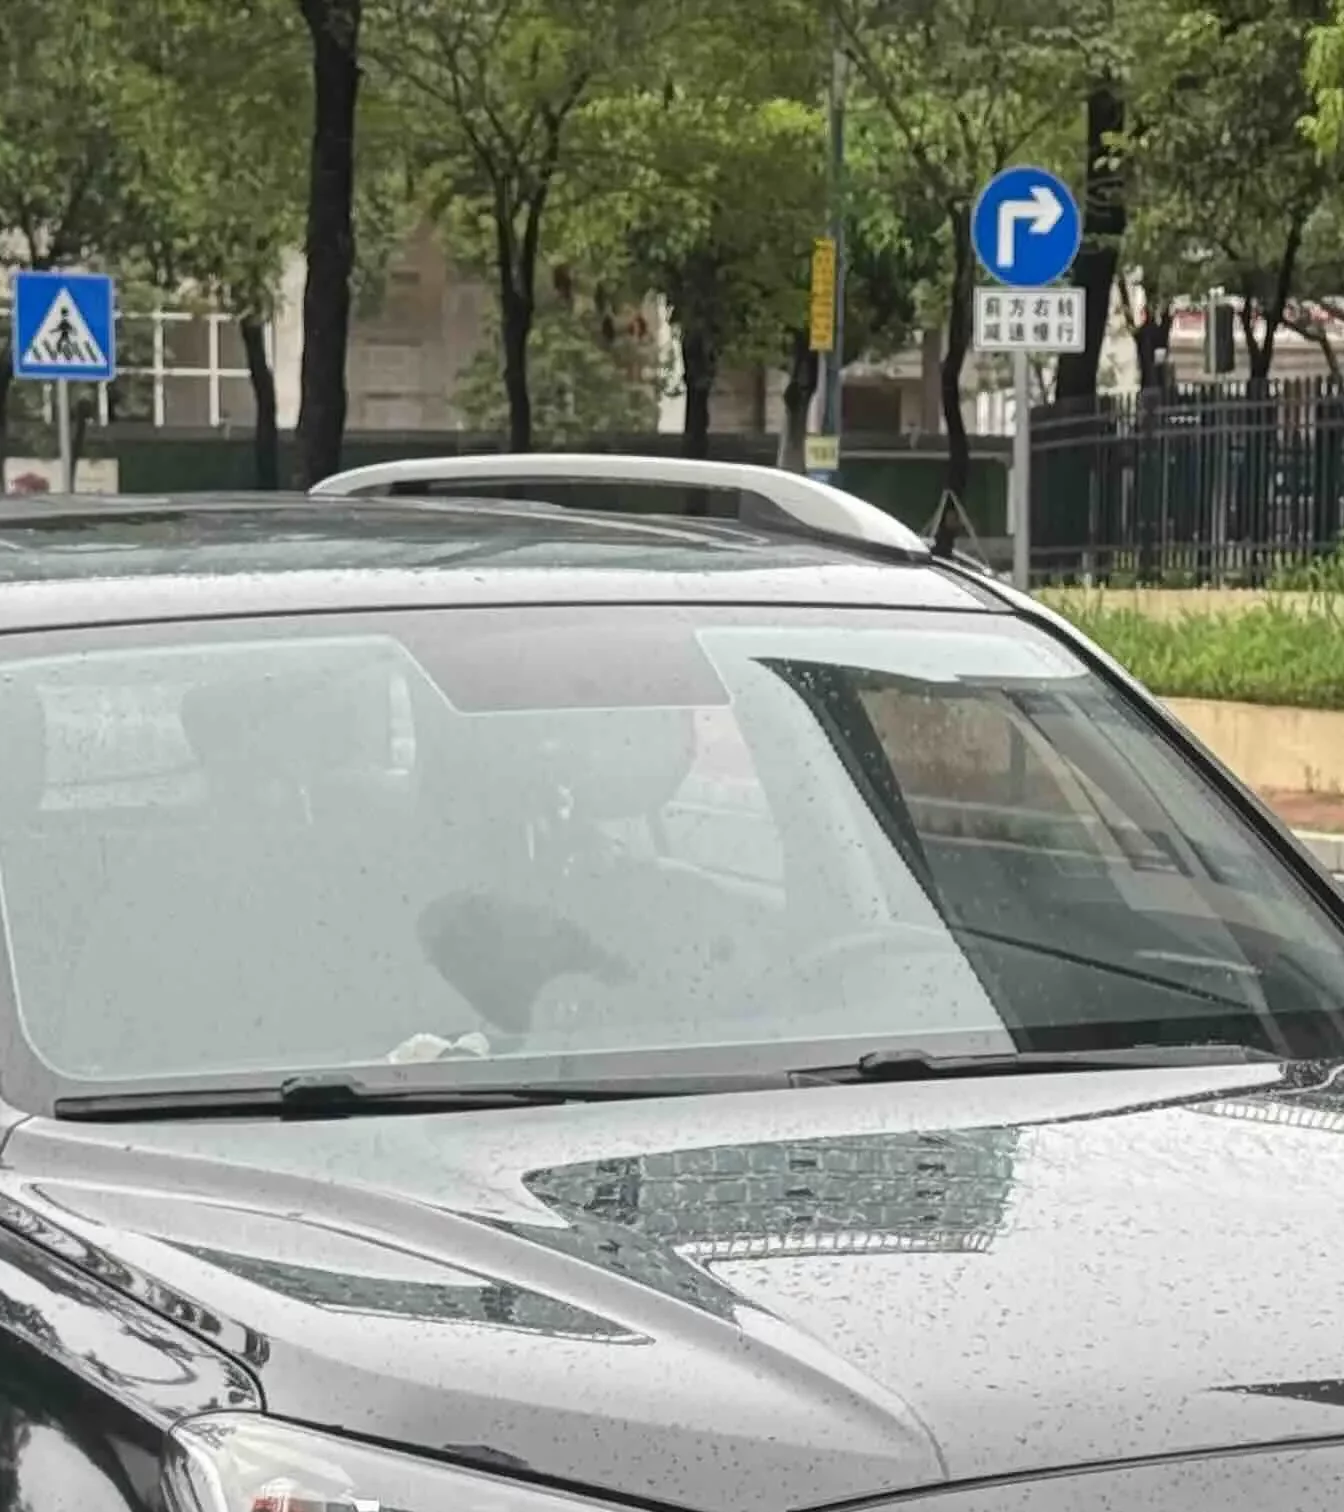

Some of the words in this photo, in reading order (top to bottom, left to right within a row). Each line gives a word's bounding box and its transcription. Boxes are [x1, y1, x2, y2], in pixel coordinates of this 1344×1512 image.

[985, 296, 1073, 318] 前方右转
[983, 322, 1074, 343] 减速慢行
